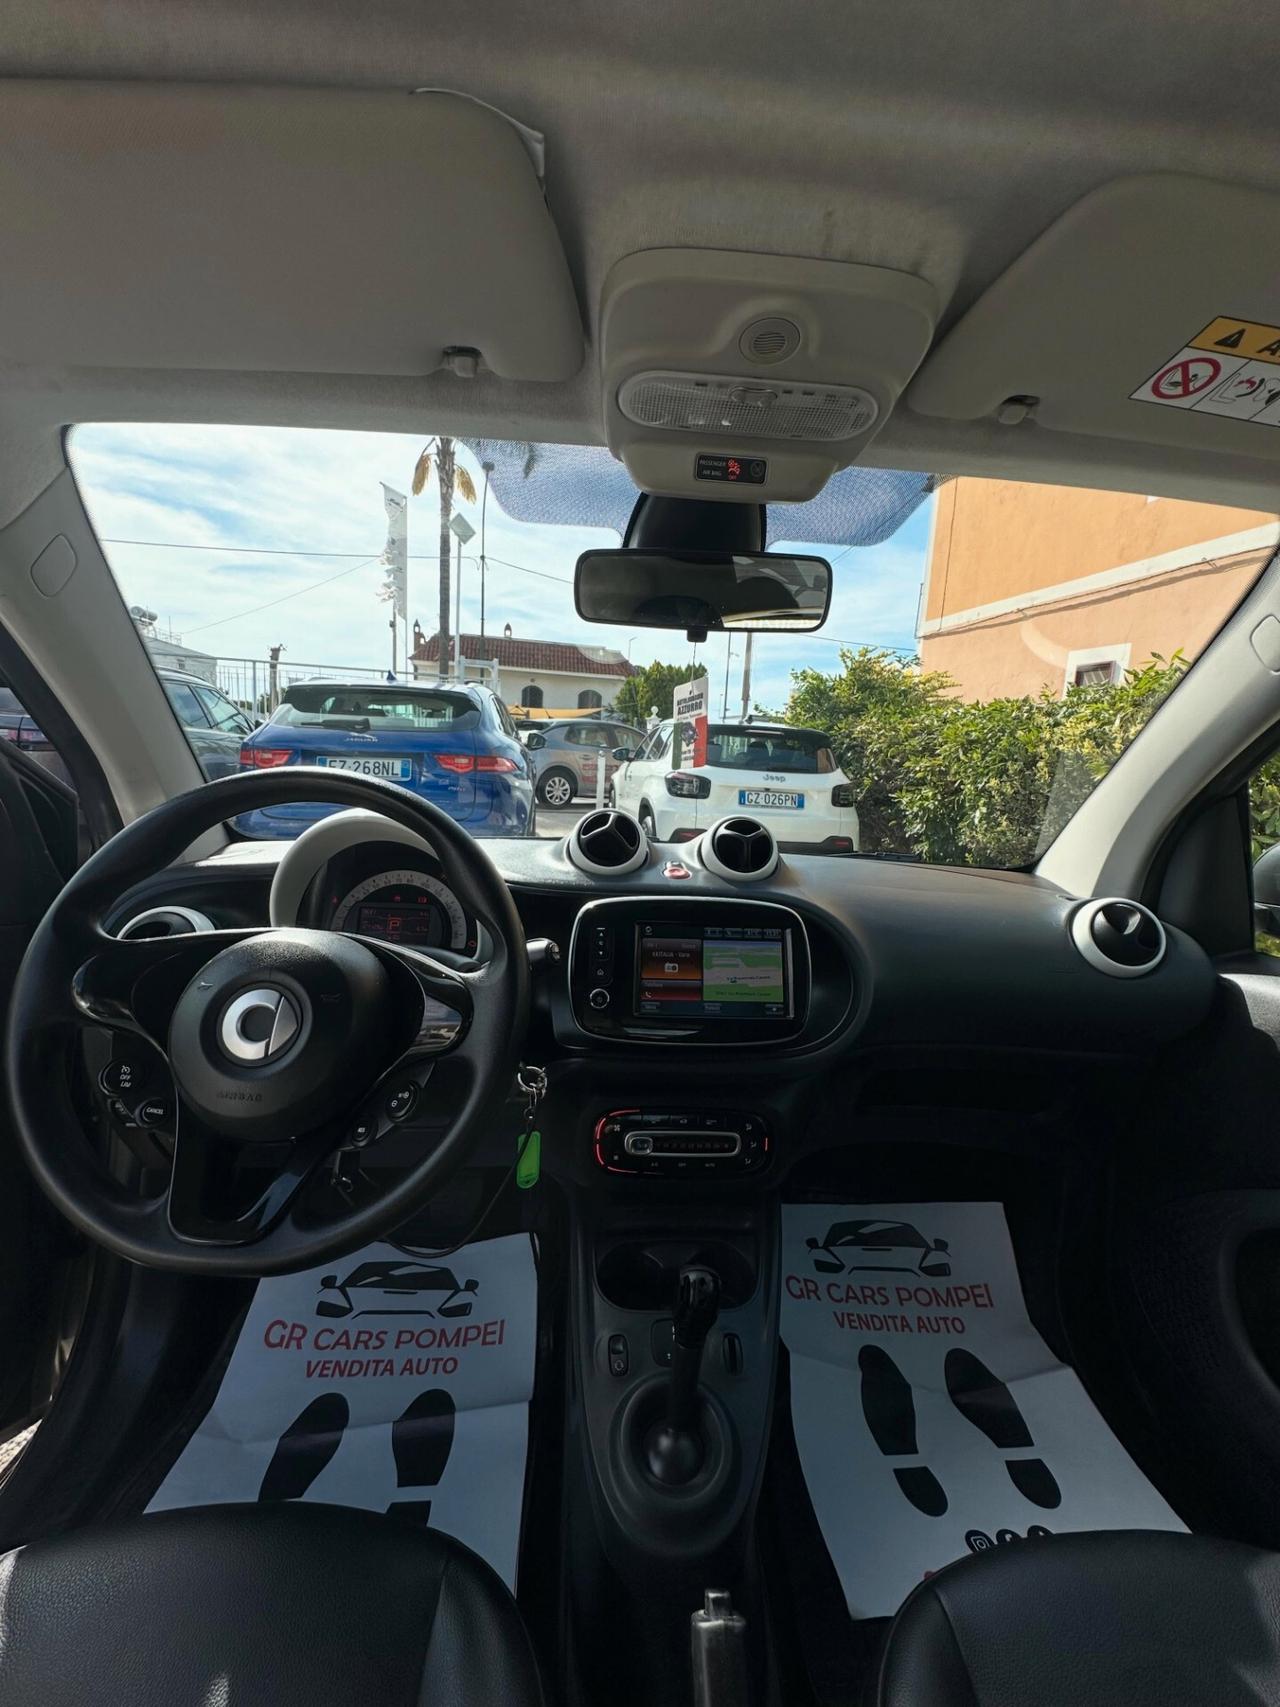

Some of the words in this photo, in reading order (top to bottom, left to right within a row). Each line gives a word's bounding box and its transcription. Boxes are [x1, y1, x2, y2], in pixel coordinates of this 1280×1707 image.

[763, 774, 786, 783] Jeep
[146, 1107, 164, 1115] CANCEL
[785, 1275, 821, 1301] GR
[827, 1282, 890, 1306] CARS
[895, 1282, 995, 1308] POMPEI
[833, 1311, 913, 1332] VENDITA
[917, 1315, 966, 1334] AUTO
[264, 1319, 308, 1350] GR
[313, 1328, 389, 1351] CARS
[394, 1319, 506, 1350] POMPEI
[305, 1359, 395, 1379] VENDITA
[399, 1357, 459, 1376] AUTO
